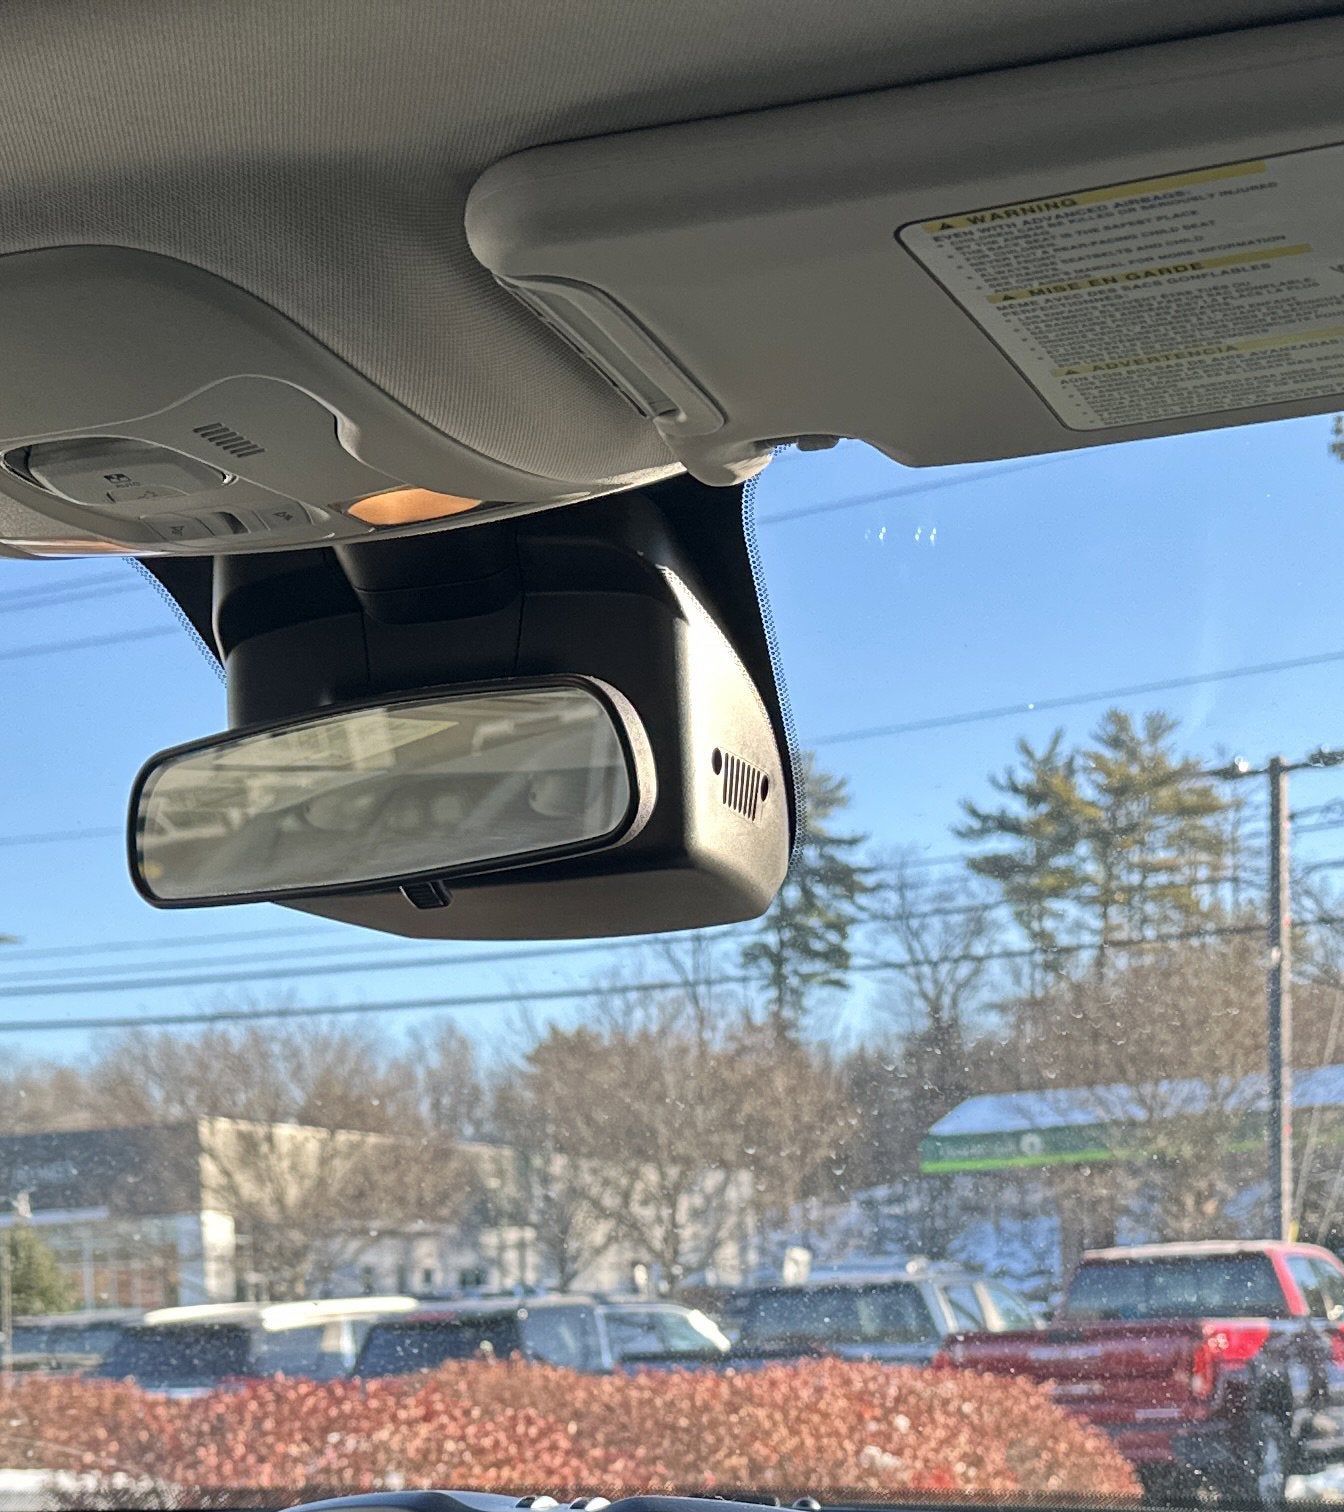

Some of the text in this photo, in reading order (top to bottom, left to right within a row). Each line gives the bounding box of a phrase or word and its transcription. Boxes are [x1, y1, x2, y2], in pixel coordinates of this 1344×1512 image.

[965, 197, 1079, 225] WARNING
[1027, 261, 1203, 296] MISE EN GARDE
[1089, 344, 1239, 371] ADVERTENCIA
